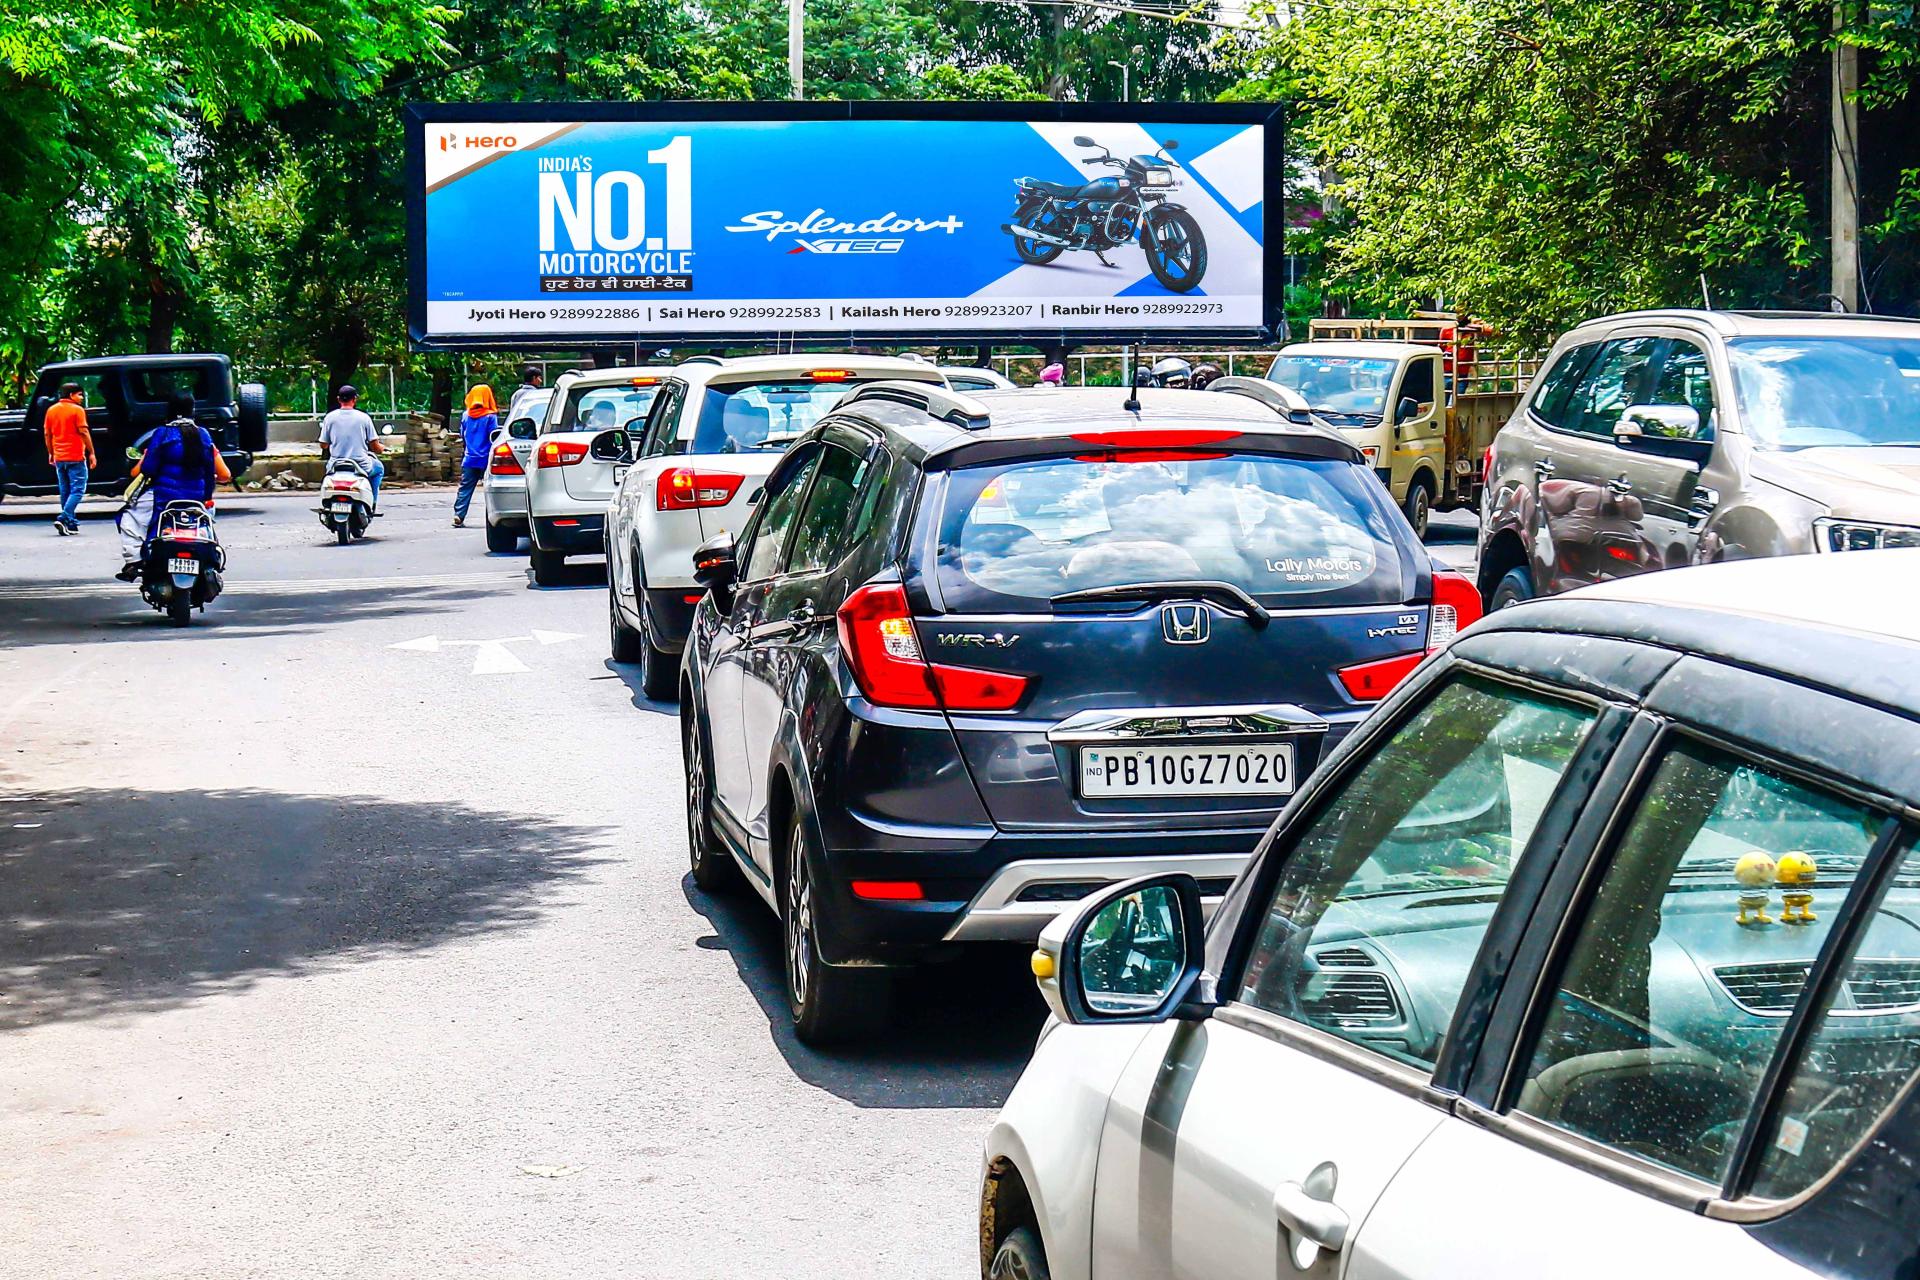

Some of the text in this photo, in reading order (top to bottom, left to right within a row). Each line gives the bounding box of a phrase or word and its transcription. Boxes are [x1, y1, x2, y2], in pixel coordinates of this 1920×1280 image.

[465, 136, 517, 148] Hero
[539, 155, 592, 171] INDIA'S
[539, 135, 692, 251] NO.1
[786, 238, 905, 254] XTEC
[601, 277, 618, 289] ਵੀ
[468, 303, 1223, 322] Jyoti Hero 9289922886 Sai Hero 9289922583 Kailash Hero 9289923207 Ranbir Hero 9289922973
[1265, 557, 1362, 573] Lally Motors
[1286, 573, 1314, 582] Simply
[1400, 615, 1417, 624] VX
[937, 633, 1021, 648] WR-V
[1086, 753, 1288, 786] IND PB10GZ7020
